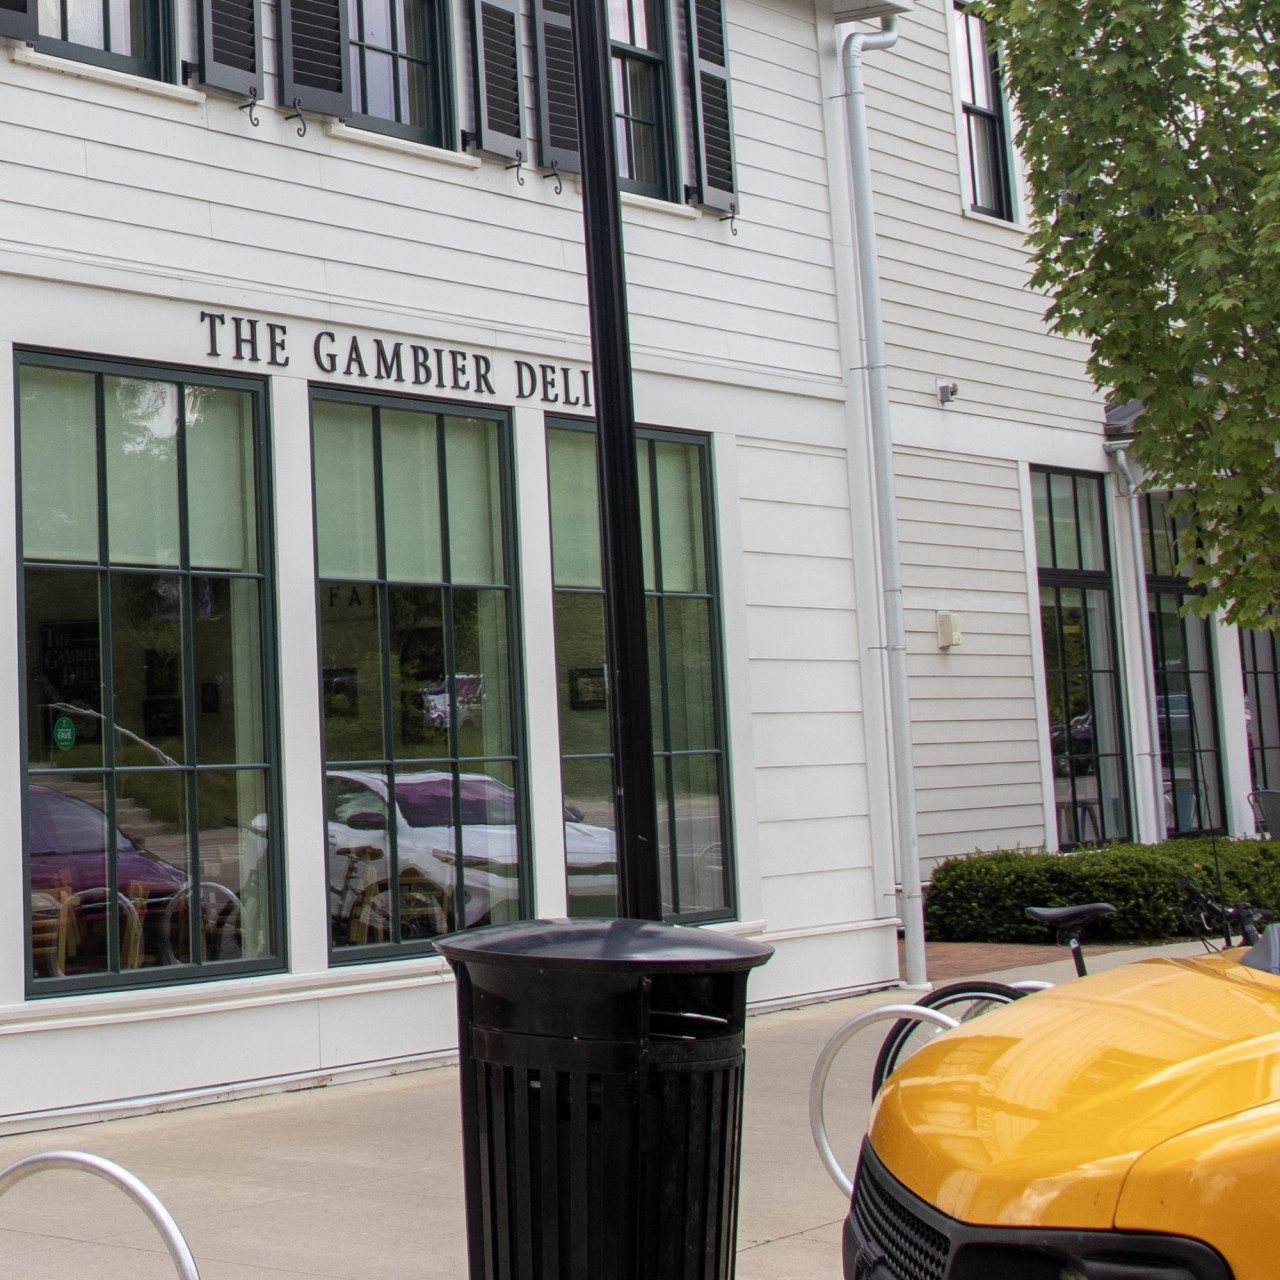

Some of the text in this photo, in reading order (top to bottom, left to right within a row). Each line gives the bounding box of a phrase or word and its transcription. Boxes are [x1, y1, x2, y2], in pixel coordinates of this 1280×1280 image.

[200, 310, 593, 408] THE GAMBIER DELI
[57, 731, 72, 740] FAVE
